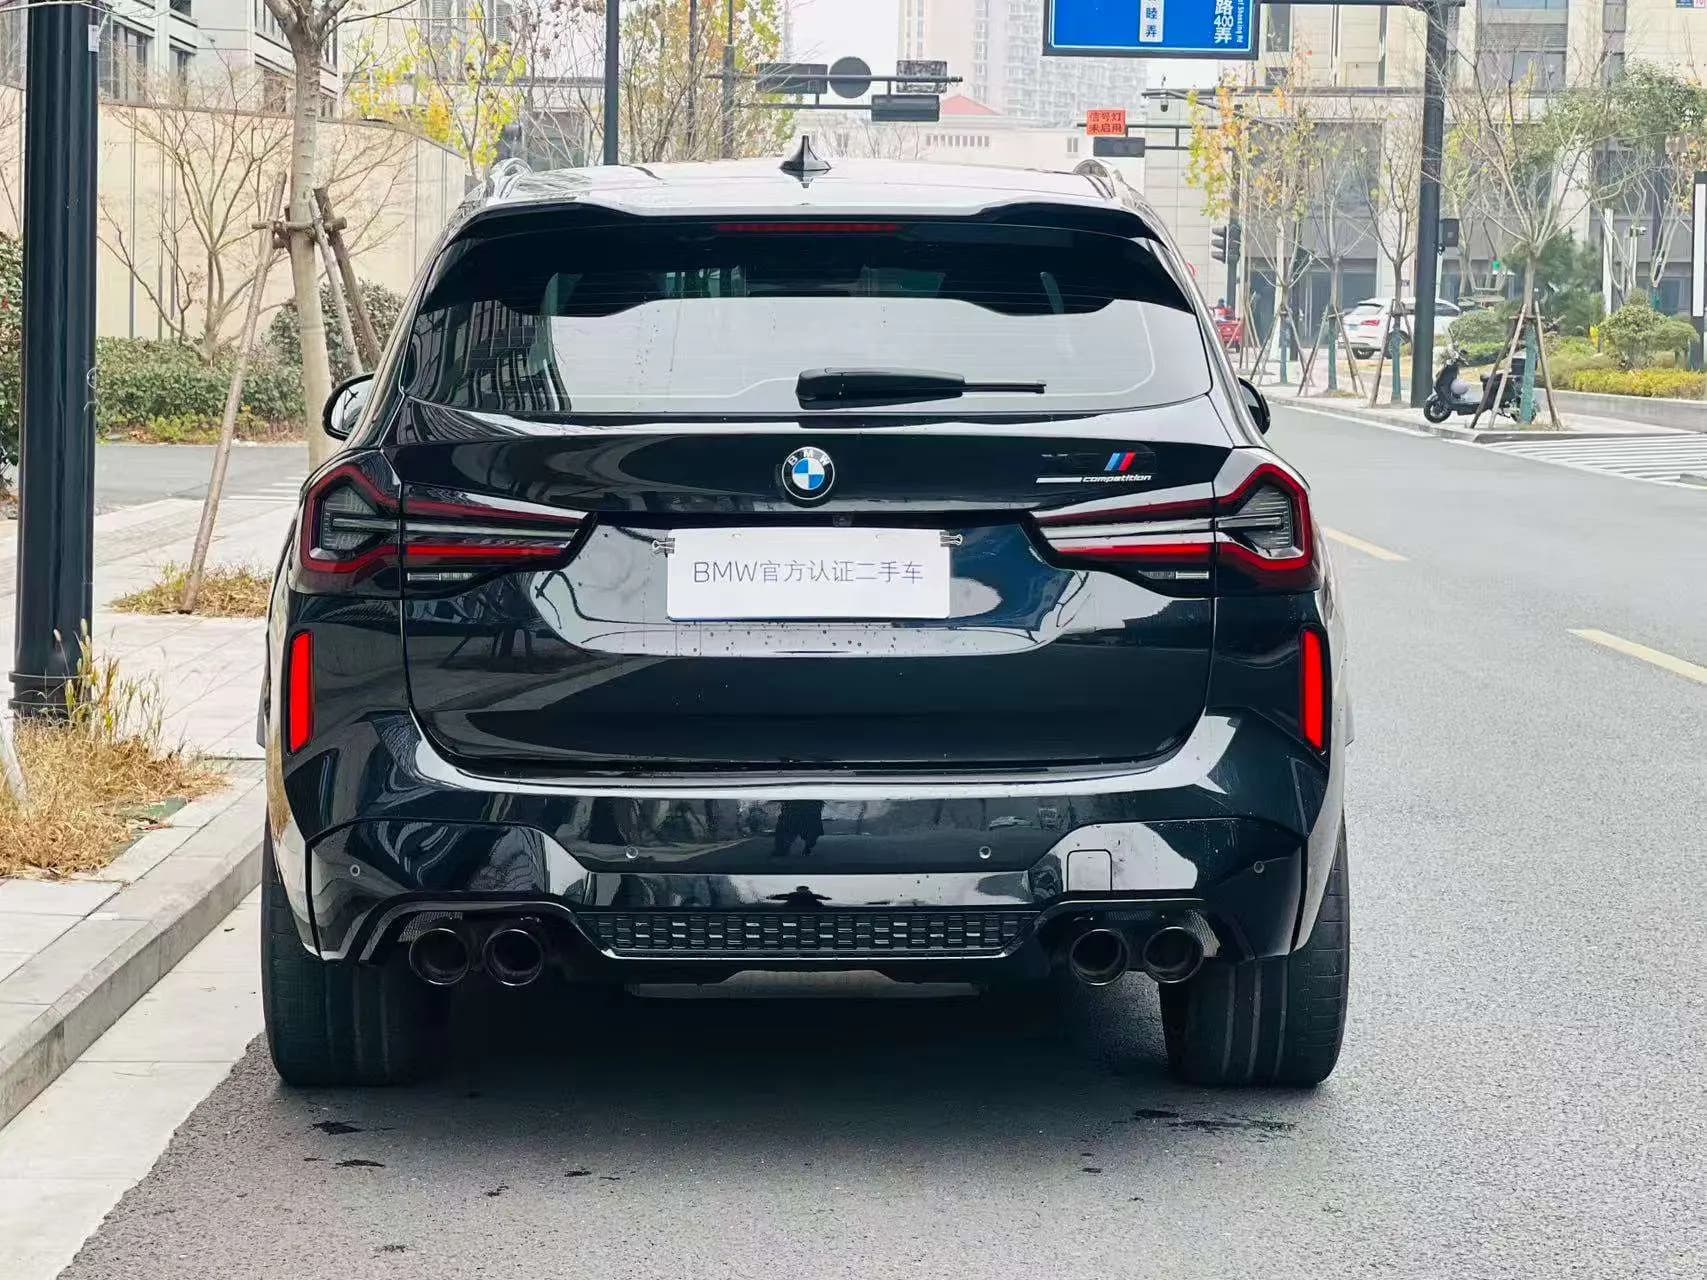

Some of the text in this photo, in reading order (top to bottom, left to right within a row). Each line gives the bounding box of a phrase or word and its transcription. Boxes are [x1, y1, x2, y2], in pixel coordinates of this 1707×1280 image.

[1089, 112, 1121, 122] 信号灯
[1088, 123, 1122, 133] 未启用
[787, 449, 831, 466] BMW
[1083, 474, 1152, 483] competition
[693, 560, 924, 585] BMW官方认证二手车
